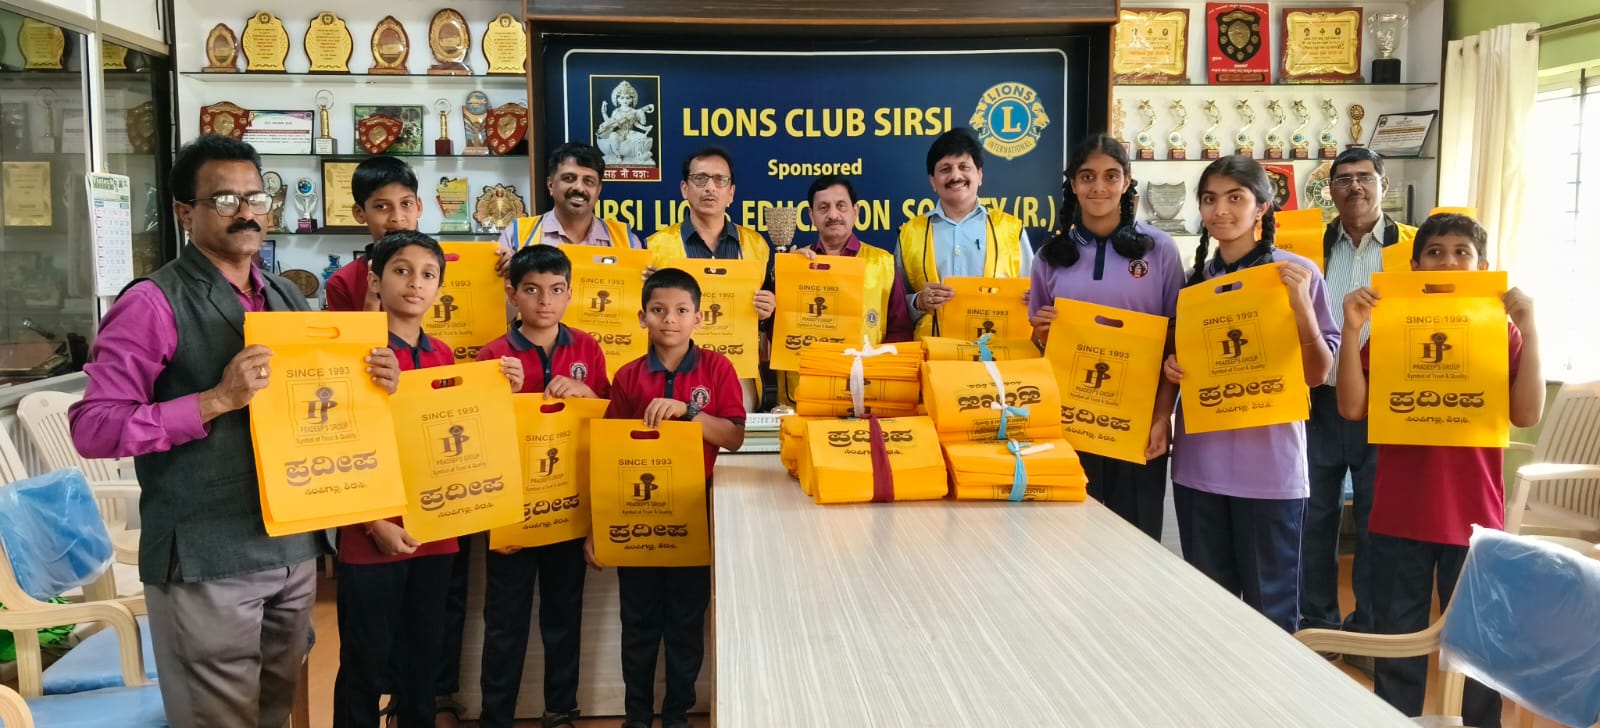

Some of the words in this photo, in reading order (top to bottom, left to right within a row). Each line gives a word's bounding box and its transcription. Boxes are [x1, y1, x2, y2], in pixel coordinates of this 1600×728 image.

[987, 85, 1033, 102] LIONS
[683, 108, 777, 137] LIONS
[784, 108, 866, 138] CLUB
[874, 107, 952, 136] SIRSI
[1001, 106, 1021, 133] L
[988, 139, 1032, 154] INTERNATIONAL
[768, 157, 863, 181] Sponsored
[595, 199, 643, 231] IRSI
[450, 279, 471, 287] 1993
[580, 277, 605, 285] SINCE
[798, 284, 821, 292] SINCE
[967, 308, 990, 316] SINCE
[1203, 315, 1233, 326] SINCE
[1236, 311, 1259, 321] 1993
[1406, 316, 1440, 324] SINCE
[1444, 315, 1468, 323] 1993
[1076, 344, 1106, 355] SINCE
[1109, 350, 1130, 359] 1993
[286, 367, 325, 378] SINCE
[328, 366, 350, 376] 1993
[1198, 376, 1284, 407] ಪ್ರದೀಪ
[1389, 390, 1485, 413] ಪ್ರದೀಪ
[421, 409, 454, 422] SINCE
[457, 405, 480, 416] 1993
[525, 433, 554, 442] SINCE
[284, 448, 378, 487] ಪ್ರದೀಪ
[618, 458, 647, 466] SINCE
[651, 458, 672, 466] 1993
[419, 474, 504, 512] ಪ್ರದೀಪ
[608, 523, 688, 544] ಪ್ರದೀಪ
